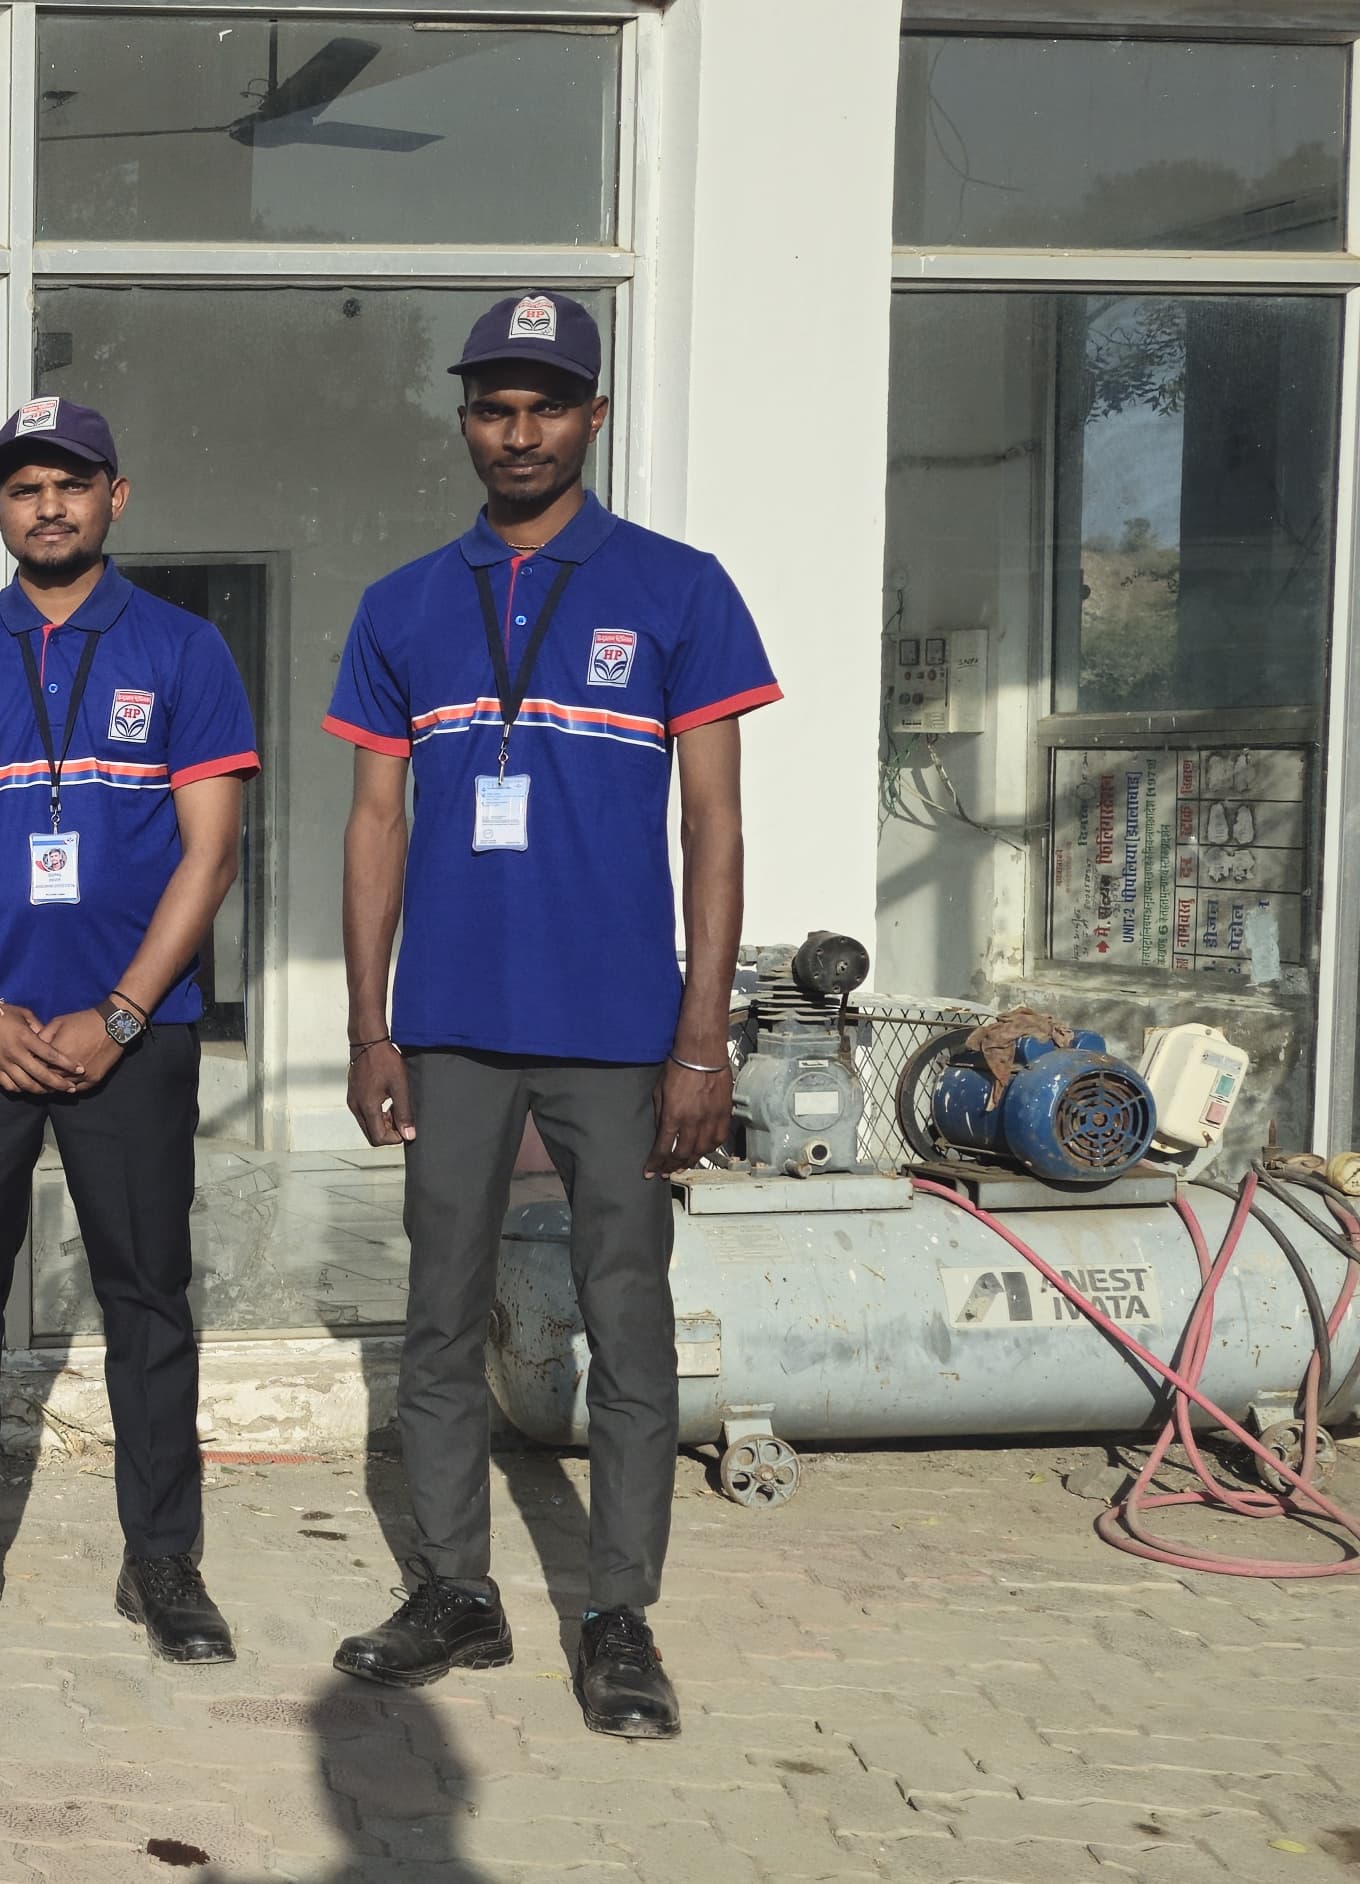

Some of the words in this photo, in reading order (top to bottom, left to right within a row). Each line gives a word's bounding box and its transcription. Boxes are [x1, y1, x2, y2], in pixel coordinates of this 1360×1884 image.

[604, 650, 623, 660] HP
[123, 708, 141, 718] HP
[1123, 908, 1135, 943] UNIT-2
